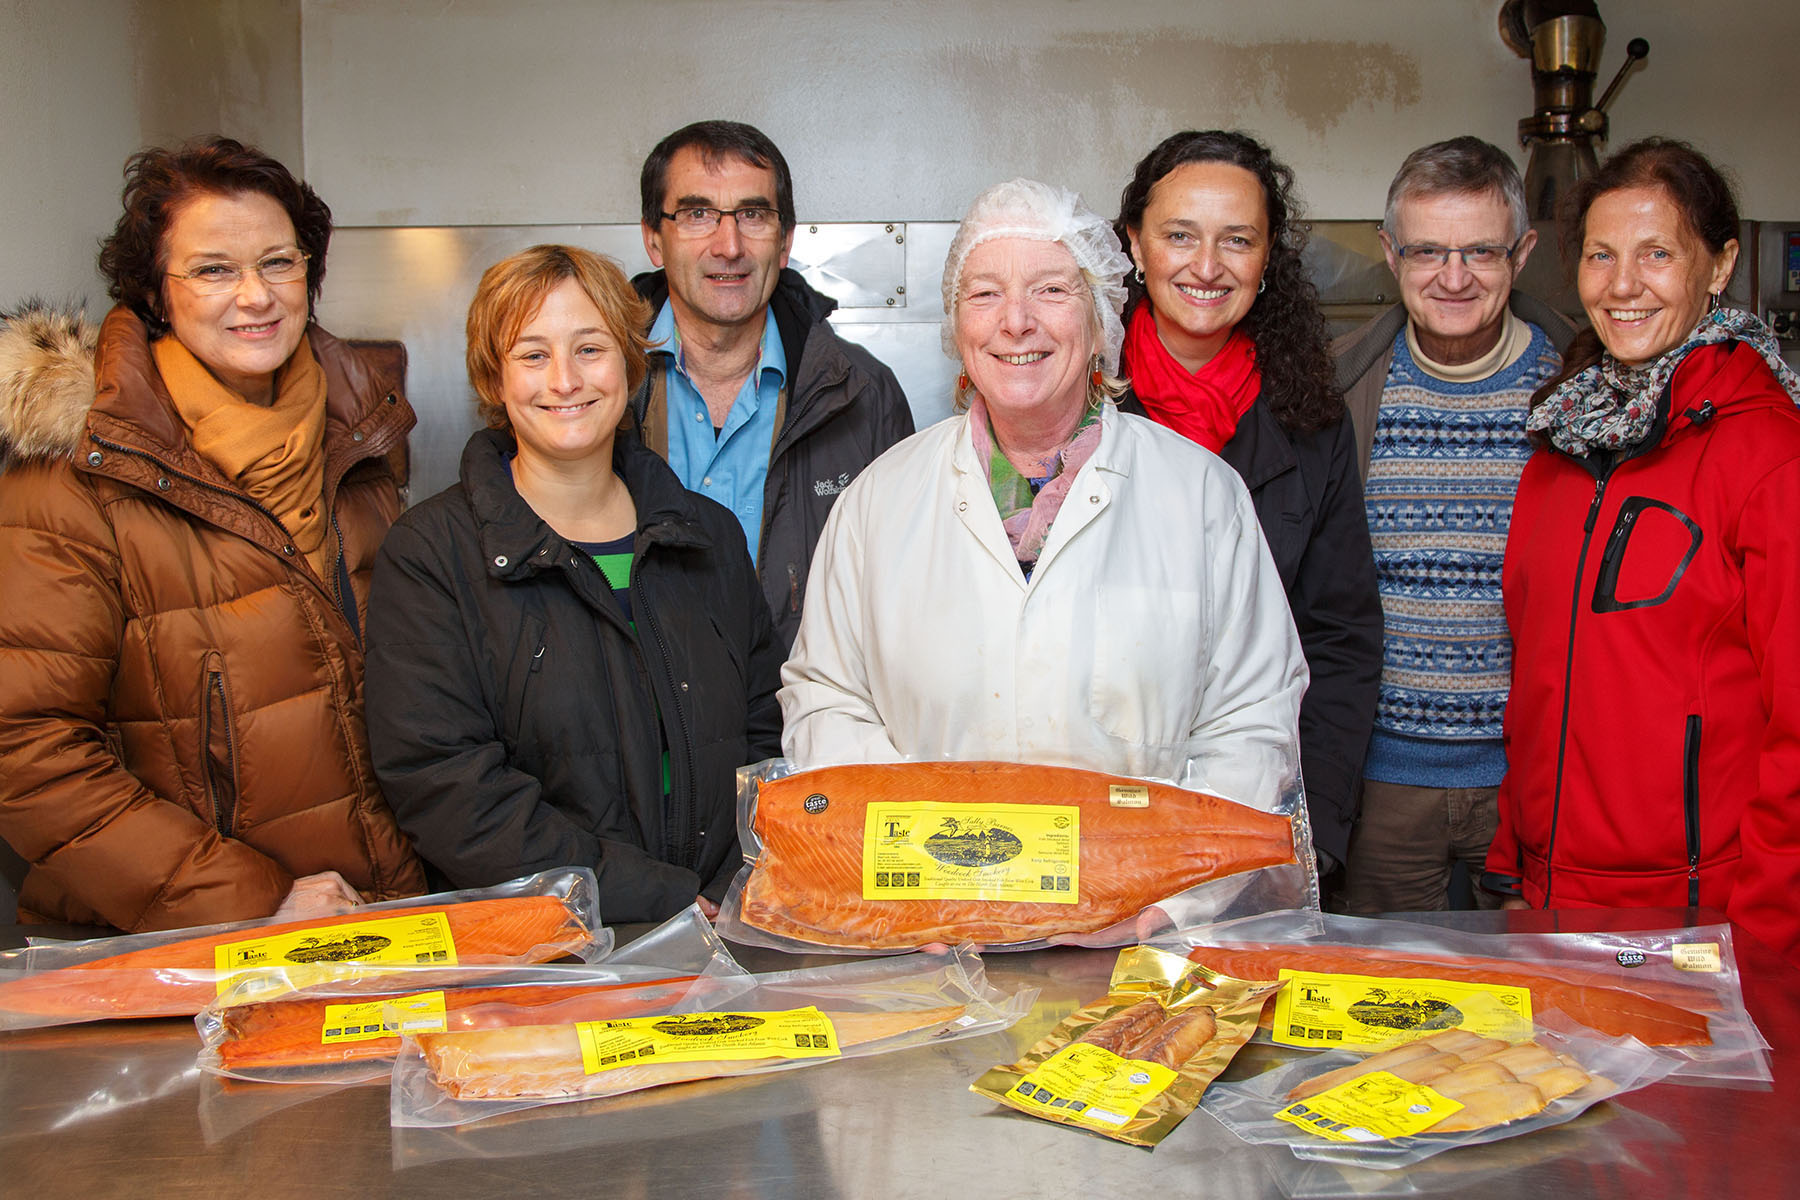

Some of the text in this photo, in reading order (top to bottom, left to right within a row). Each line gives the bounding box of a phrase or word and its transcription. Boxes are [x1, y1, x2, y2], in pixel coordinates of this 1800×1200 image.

[814, 479, 834, 490] Jack
[806, 799, 827, 808] taste
[885, 822, 911, 838] Taste
[237, 948, 268, 960] Taste
[1618, 954, 1644, 962] taste
[1301, 987, 1331, 1004] Taste
